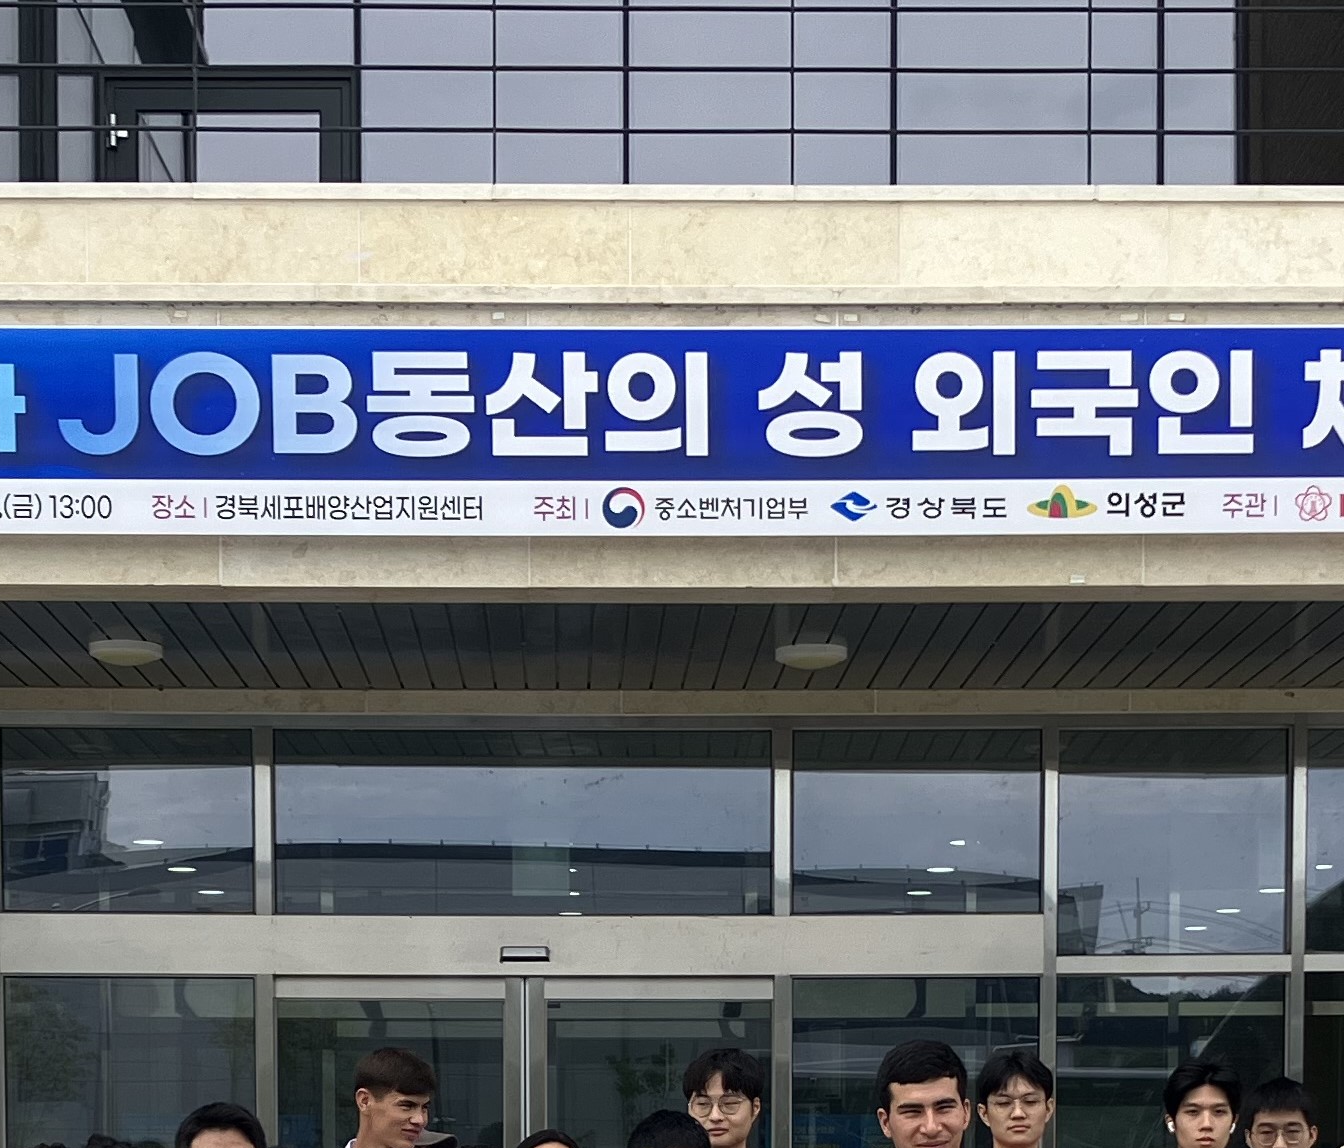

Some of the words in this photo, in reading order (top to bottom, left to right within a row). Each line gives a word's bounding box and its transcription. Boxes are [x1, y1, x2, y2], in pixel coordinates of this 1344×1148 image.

[58, 351, 709, 458] JOB동산의
[758, 351, 864, 458] 성
[912, 349, 1254, 456] 외국인
[48, 494, 113, 519] 13:00
[152, 494, 196, 520] 장소
[215, 494, 483, 521] 경북세포배양산업지원센터
[533, 495, 576, 521] 주최
[654, 497, 808, 521] 중소벤처기업부
[886, 497, 1007, 520] 경상북도
[1106, 492, 1186, 518] 의성군
[1222, 493, 1267, 519] 주관
